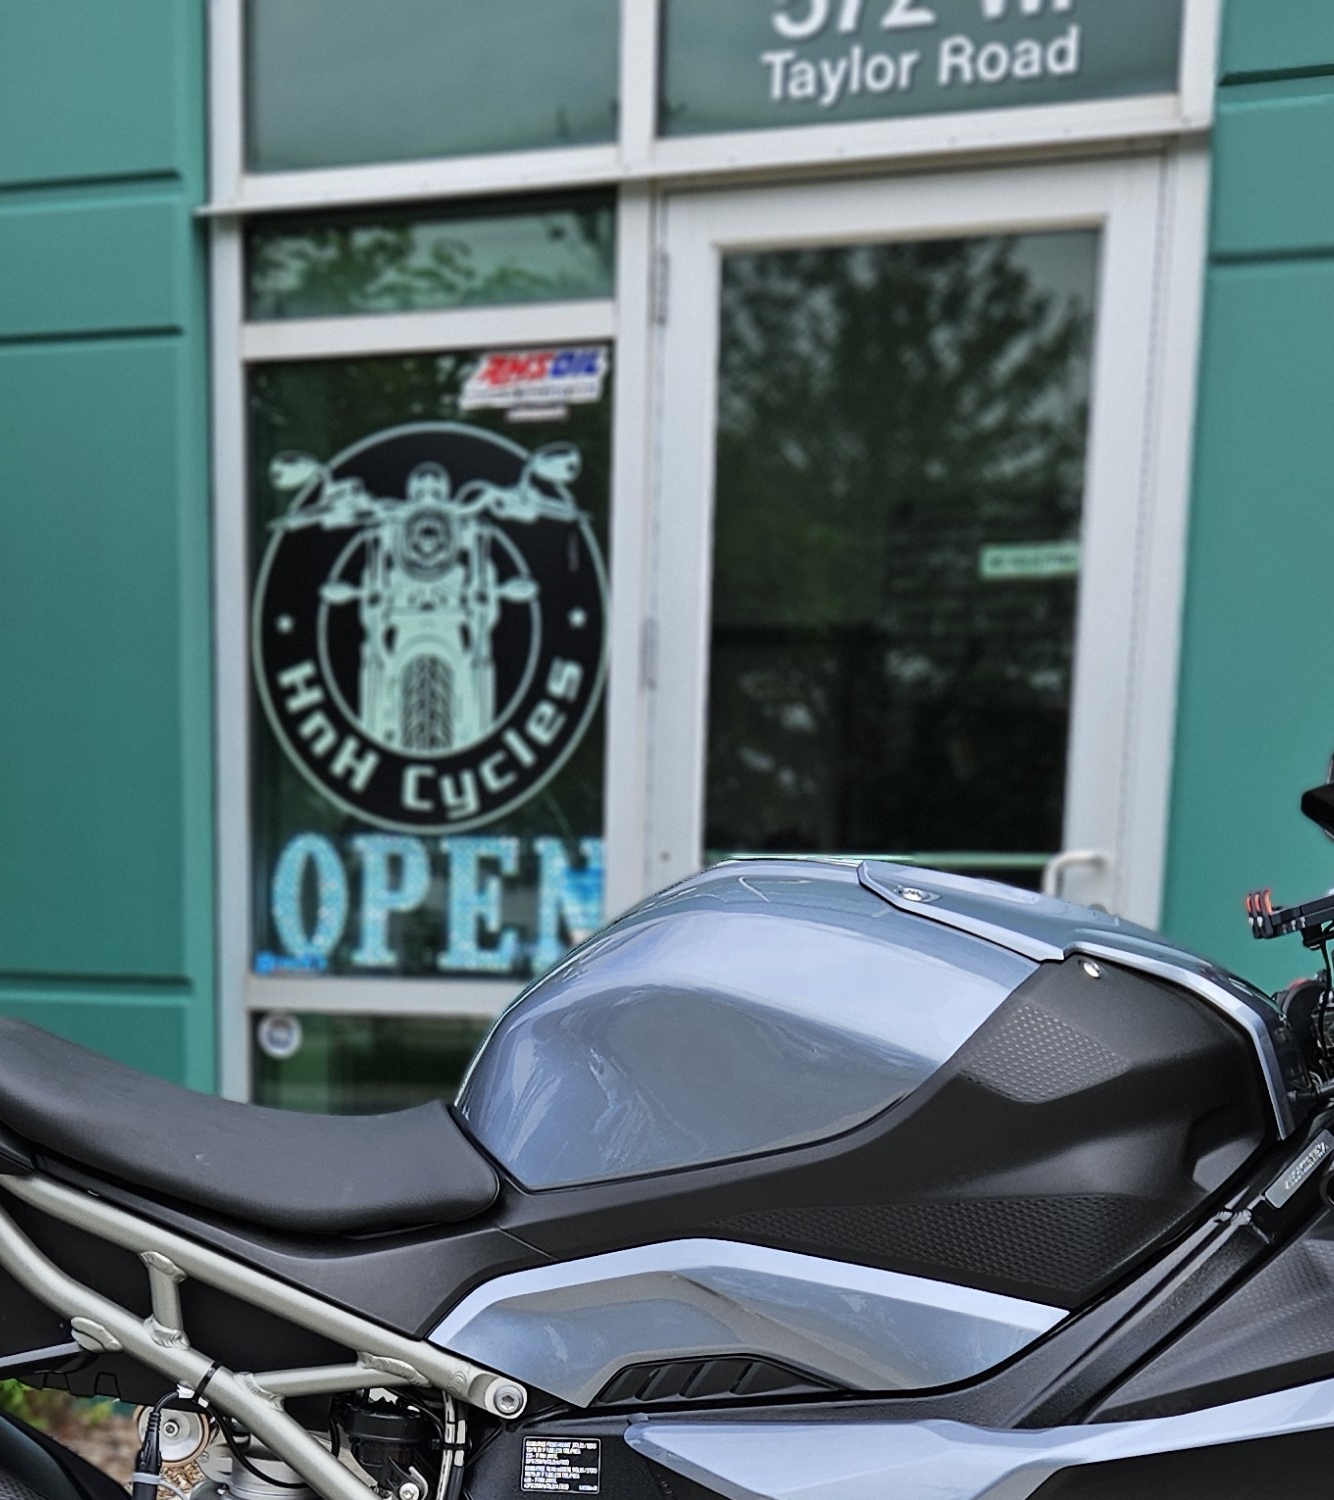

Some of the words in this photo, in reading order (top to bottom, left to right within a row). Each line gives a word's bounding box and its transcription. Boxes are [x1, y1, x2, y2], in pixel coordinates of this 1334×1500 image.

[760, 44, 919, 106] Taylor
[938, 23, 1080, 84] Road
[478, 351, 599, 387] AMSOIL
[277, 660, 379, 792] HnH
[402, 657, 583, 820] Cycles
[271, 832, 603, 973] OPEN
